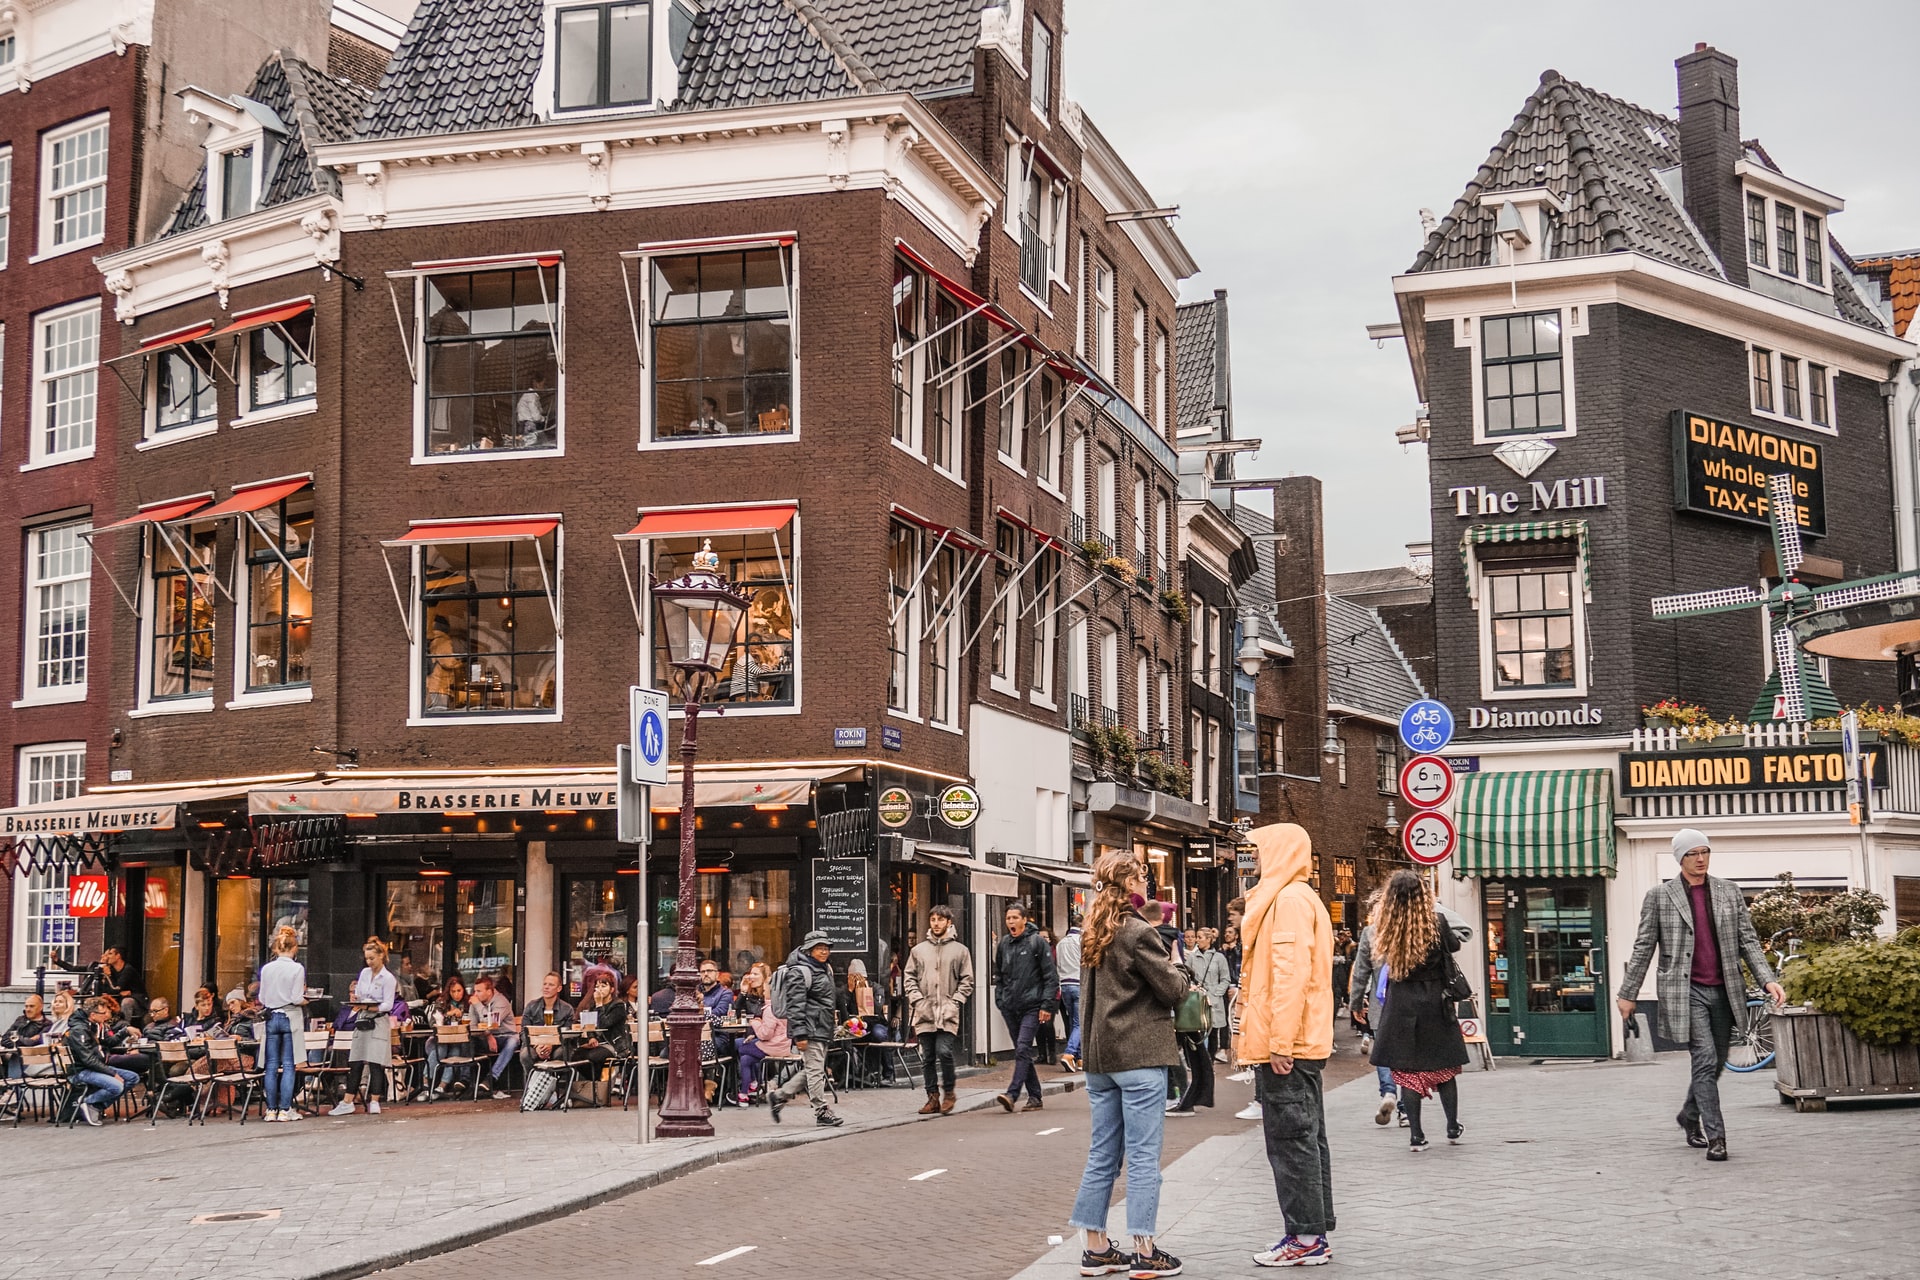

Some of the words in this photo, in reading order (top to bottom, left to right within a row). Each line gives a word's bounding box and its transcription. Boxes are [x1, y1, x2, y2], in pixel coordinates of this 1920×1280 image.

[1689, 417, 1817, 470] DIAMOND
[1703, 458, 1809, 498] wholele
[1449, 486, 1519, 517] The
[1528, 476, 1607, 511] Mill
[1704, 485, 1811, 527] TAX-FE
[643, 695, 659, 707] ZONE
[1467, 703, 1602, 729] Diamonds
[838, 730, 862, 738] ROKIN
[1419, 767, 1428, 781] 6
[1629, 757, 1750, 787] DIAMOND
[1763, 752, 1878, 784] FACTOY
[398, 791, 521, 809] BRASSERIE
[6, 816, 81, 832] BRASSERIE
[87, 811, 158, 828] MEUWESE
[72, 880, 106, 914] illy
